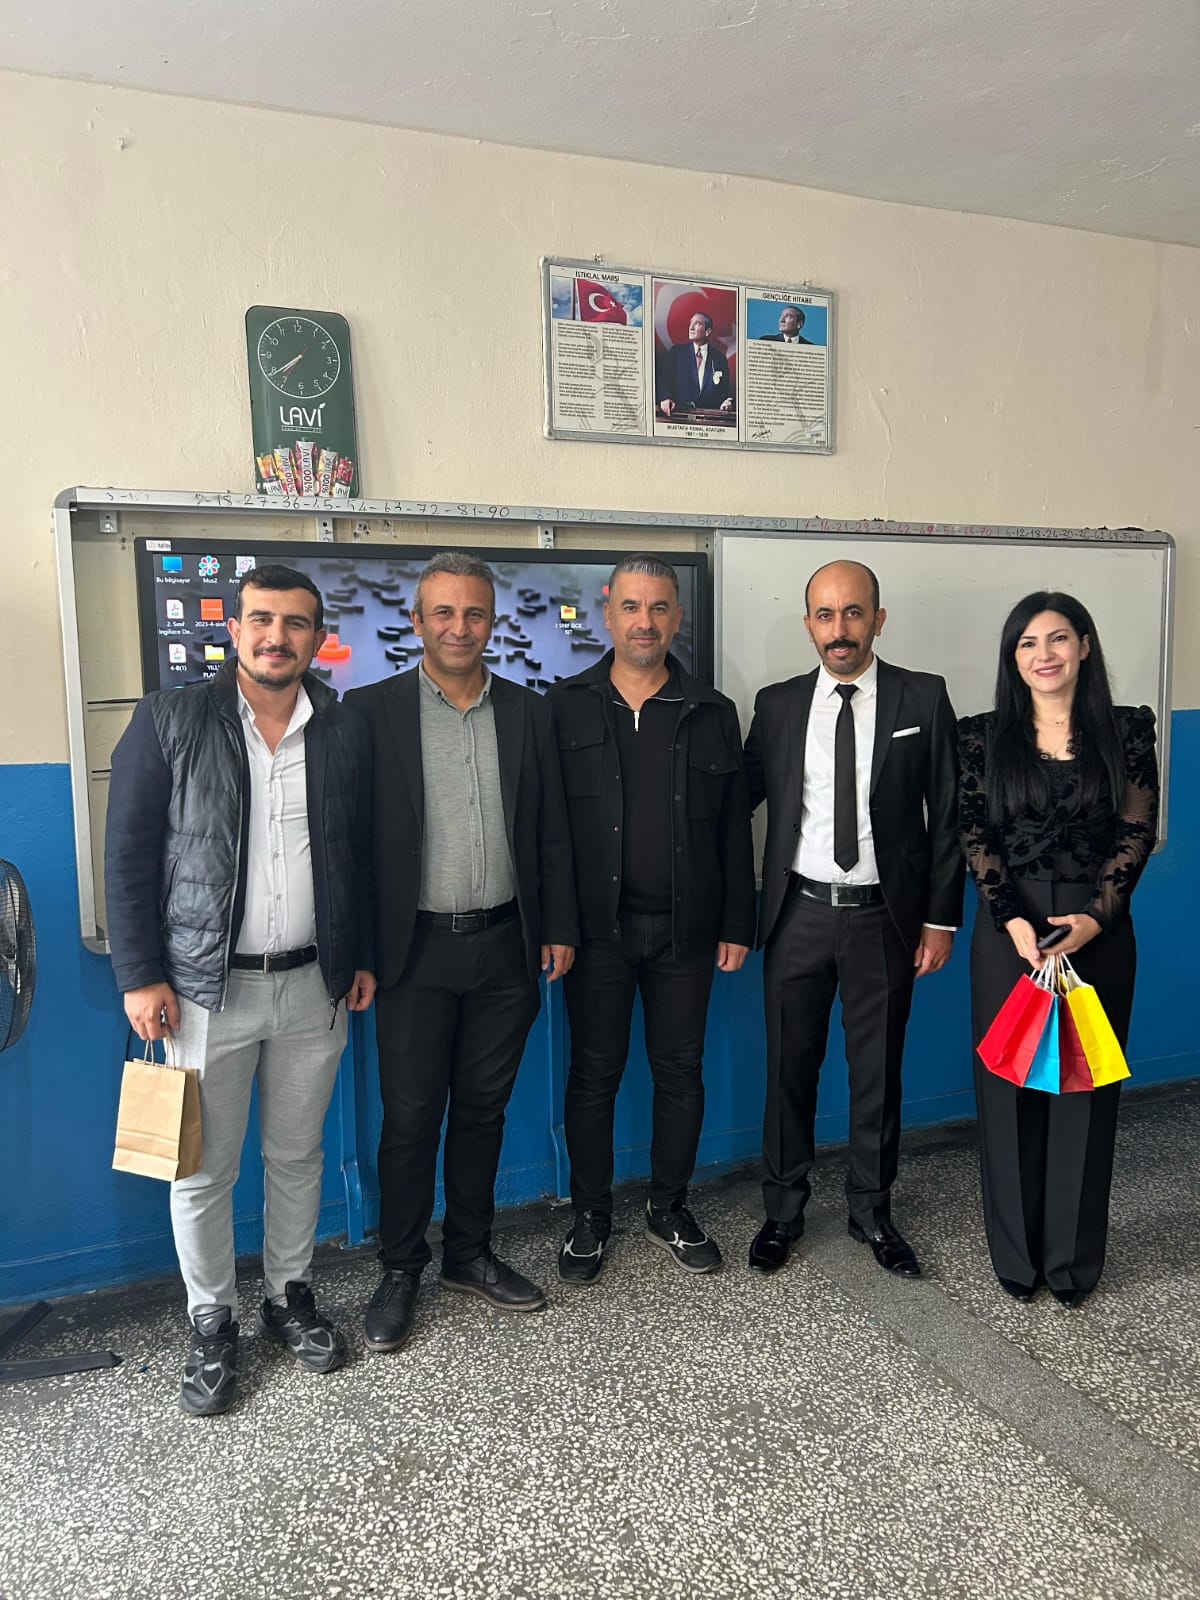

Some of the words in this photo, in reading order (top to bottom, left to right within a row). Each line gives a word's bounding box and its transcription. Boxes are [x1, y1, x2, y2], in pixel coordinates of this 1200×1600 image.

[294, 324, 302, 333] 12
[321, 341, 327, 350] 2
[266, 351, 272, 359] 9
[326, 356, 332, 365] 3
[298, 381, 304, 390] 6
[313, 379, 319, 388] 5
